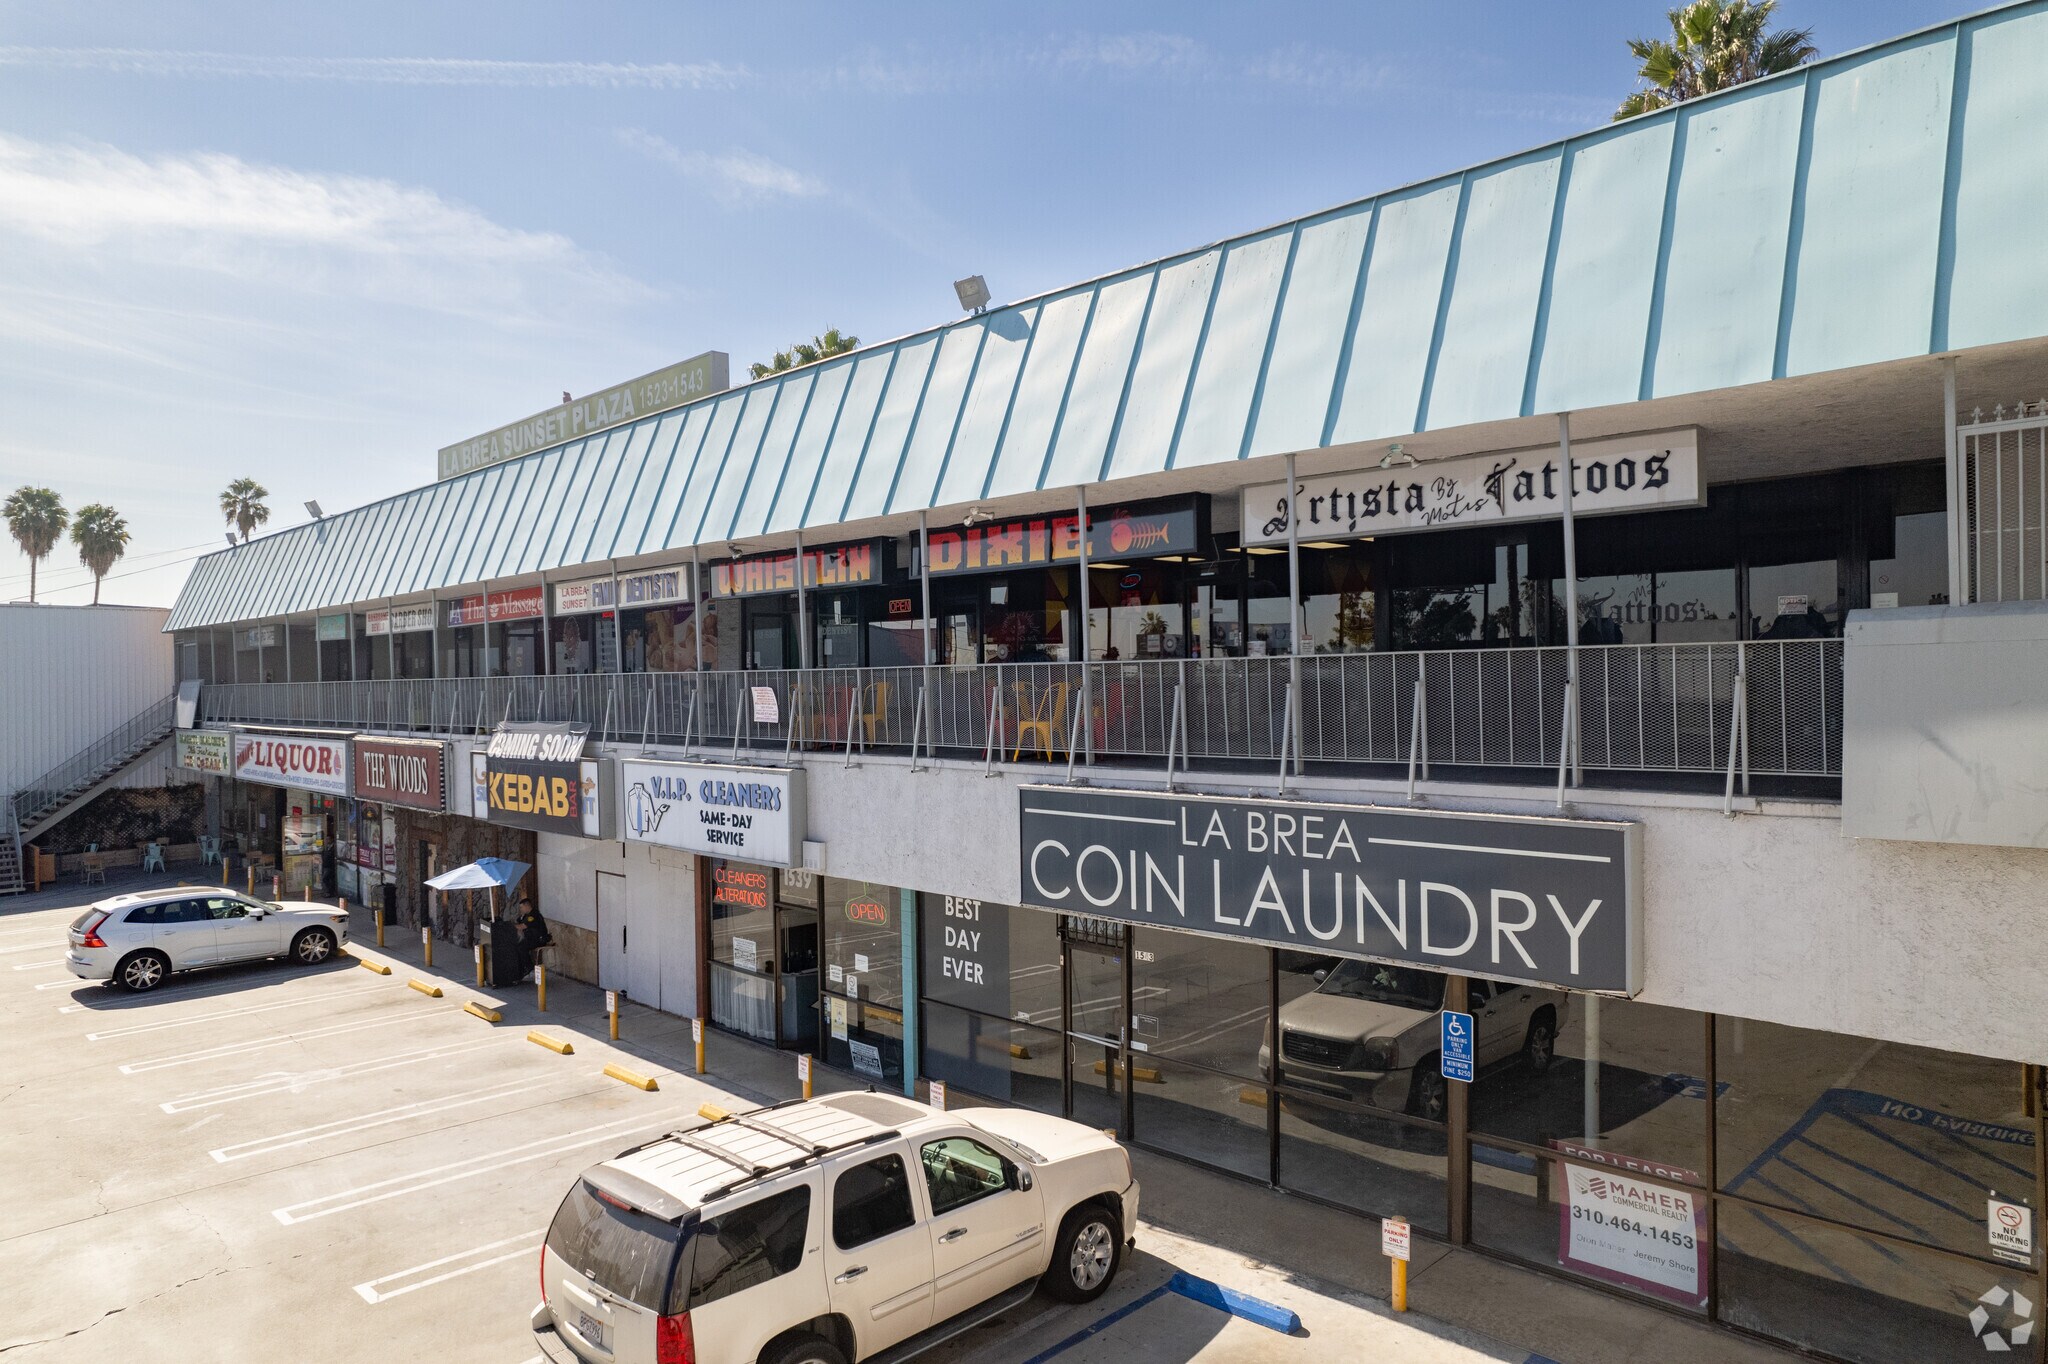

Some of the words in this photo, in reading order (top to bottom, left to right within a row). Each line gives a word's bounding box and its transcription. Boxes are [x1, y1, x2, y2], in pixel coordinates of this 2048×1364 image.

[442, 454, 460, 477] LA
[461, 435, 501, 471] BREA
[503, 410, 567, 457] SUNSET
[572, 389, 635, 434] PLAZA
[639, 367, 704, 409] 1523-1543
[1484, 449, 1672, 516] Tattoos
[928, 514, 1092, 572] DIXIE
[718, 544, 871, 595] WHISTLIN
[562, 588, 571, 598] LA
[626, 571, 680, 603] DENTISTRY
[466, 600, 485, 620] Tha
[502, 593, 543, 616] Massage
[562, 598, 588, 610] SUNSET
[254, 741, 332, 775] LIQUOR
[488, 733, 540, 760] COMING
[538, 734, 586, 762] SOON
[364, 751, 386, 788] THE
[388, 754, 428, 796] WOODS
[489, 772, 570, 818] KEBAB
[568, 780, 578, 818] BAR
[650, 776, 692, 802] V.I.P.
[700, 780, 782, 812] CLEANERS
[700, 810, 753, 830] SAME-DAY
[706, 829, 745, 847] SERVICE
[1181, 806, 1232, 850] LA
[1247, 812, 1362, 863] BREA
[716, 868, 767, 889] CLEANERS
[784, 869, 812, 888] 1539
[716, 887, 767, 908] ALTERATIONS
[945, 896, 981, 922] BEST
[1030, 838, 1186, 918] COIN
[1213, 858, 1604, 975] LAUNDRY
[850, 903, 886, 921] OPEN
[945, 926, 981, 952] DAY
[943, 956, 984, 985] EVER
[1446, 1035, 1468, 1044] PARKING
[1444, 1050, 1470, 1060] ACCESSIBLE
[1446, 1060, 1468, 1070] MINIMUM
[1444, 1066, 1456, 1074] FINE
[1458, 1069, 1471, 1078] $250
[1610, 1181, 1688, 1213] MAHER
[1612, 1196, 1659, 1215] COMMERCIAL
[1661, 1208, 1688, 1223] REALTY
[1384, 1228, 1408, 1239] PARKING
[1388, 1236, 1404, 1244] ONLY
[1572, 1204, 1694, 1250] 310.464.1453
[1992, 1232, 2029, 1247] SMOKING
[2003, 1226, 2017, 1236] NO
[1633, 1250, 1666, 1267] Jeremy
[1668, 1259, 1696, 1274] Shore
